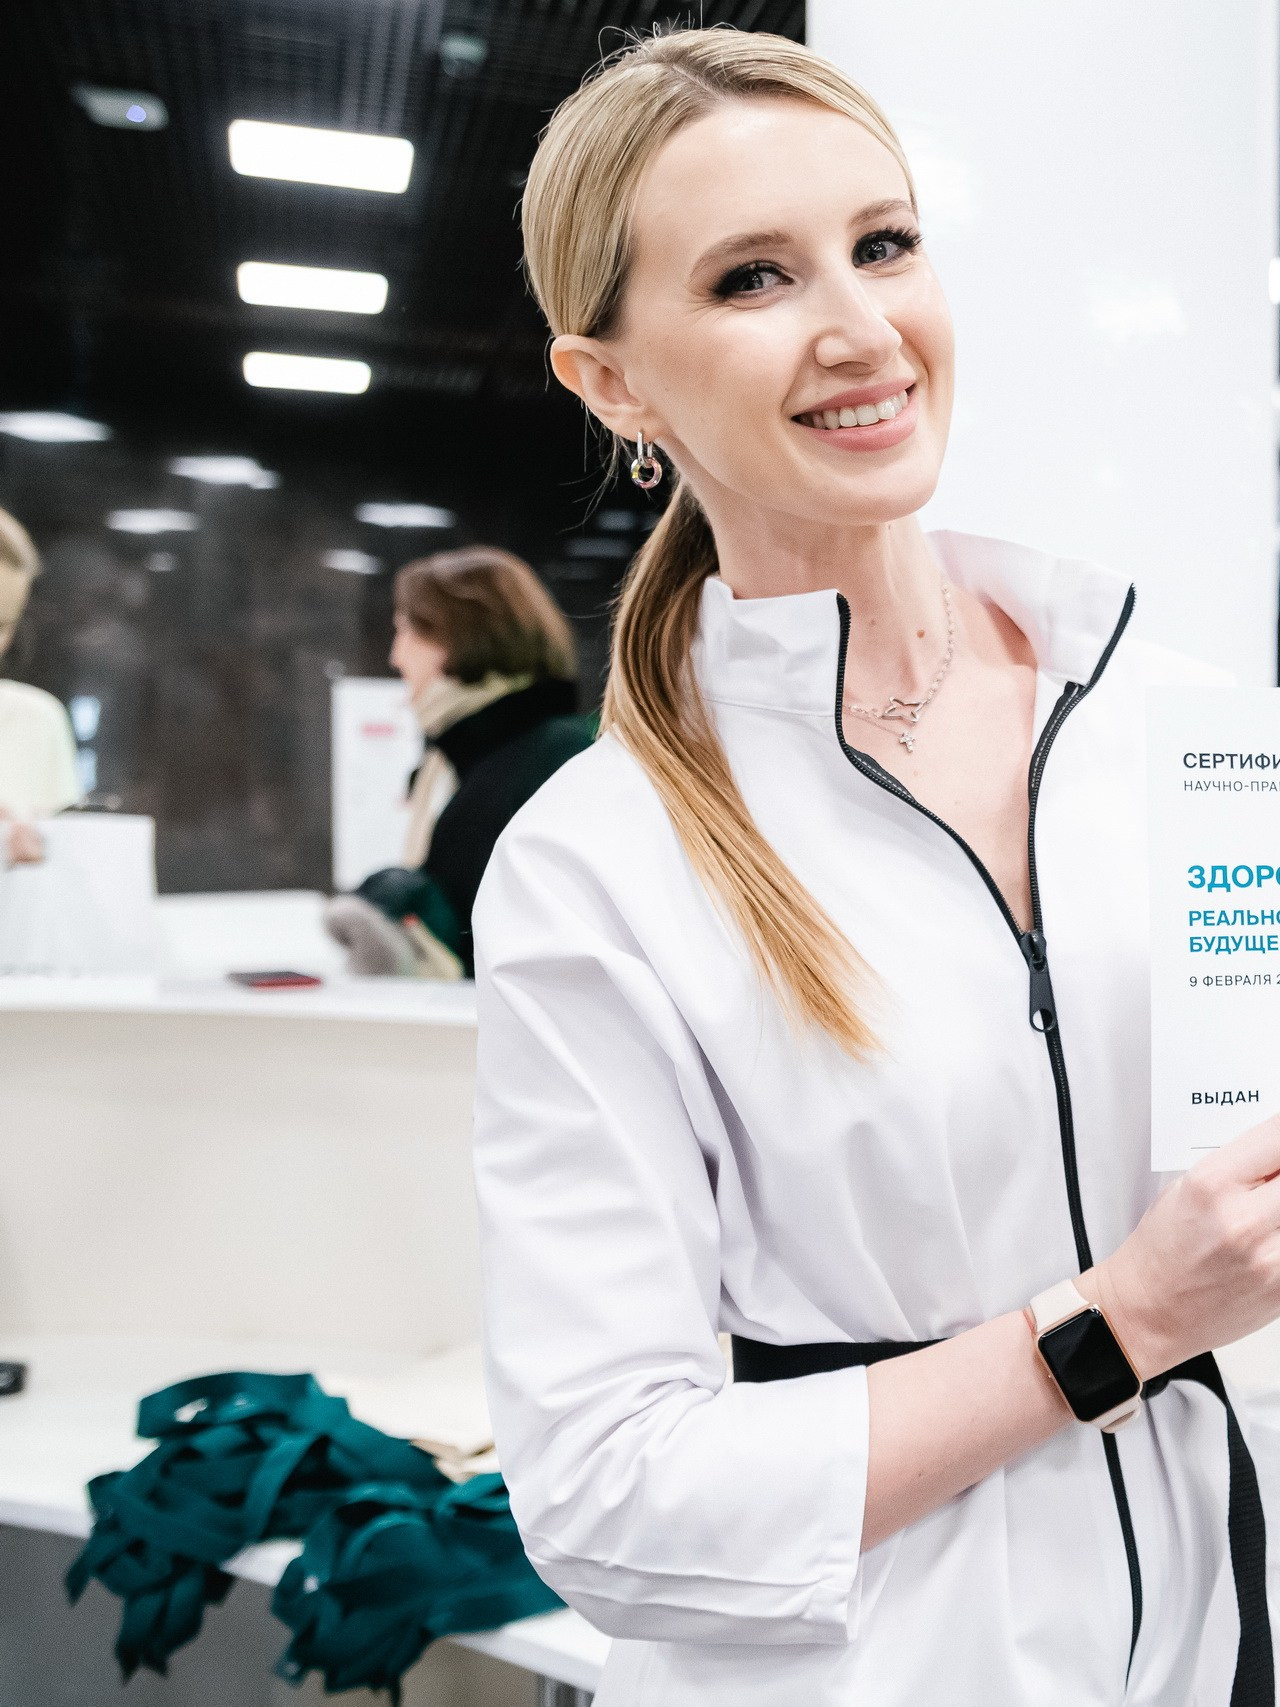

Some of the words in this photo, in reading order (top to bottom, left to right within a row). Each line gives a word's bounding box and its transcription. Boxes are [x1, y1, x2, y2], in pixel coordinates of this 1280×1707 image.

[1189, 975, 1198, 988] 9
[1202, 974, 1272, 987] ФЕВРАЛЯ
[1191, 1089, 1259, 1107] ВЫДАН
